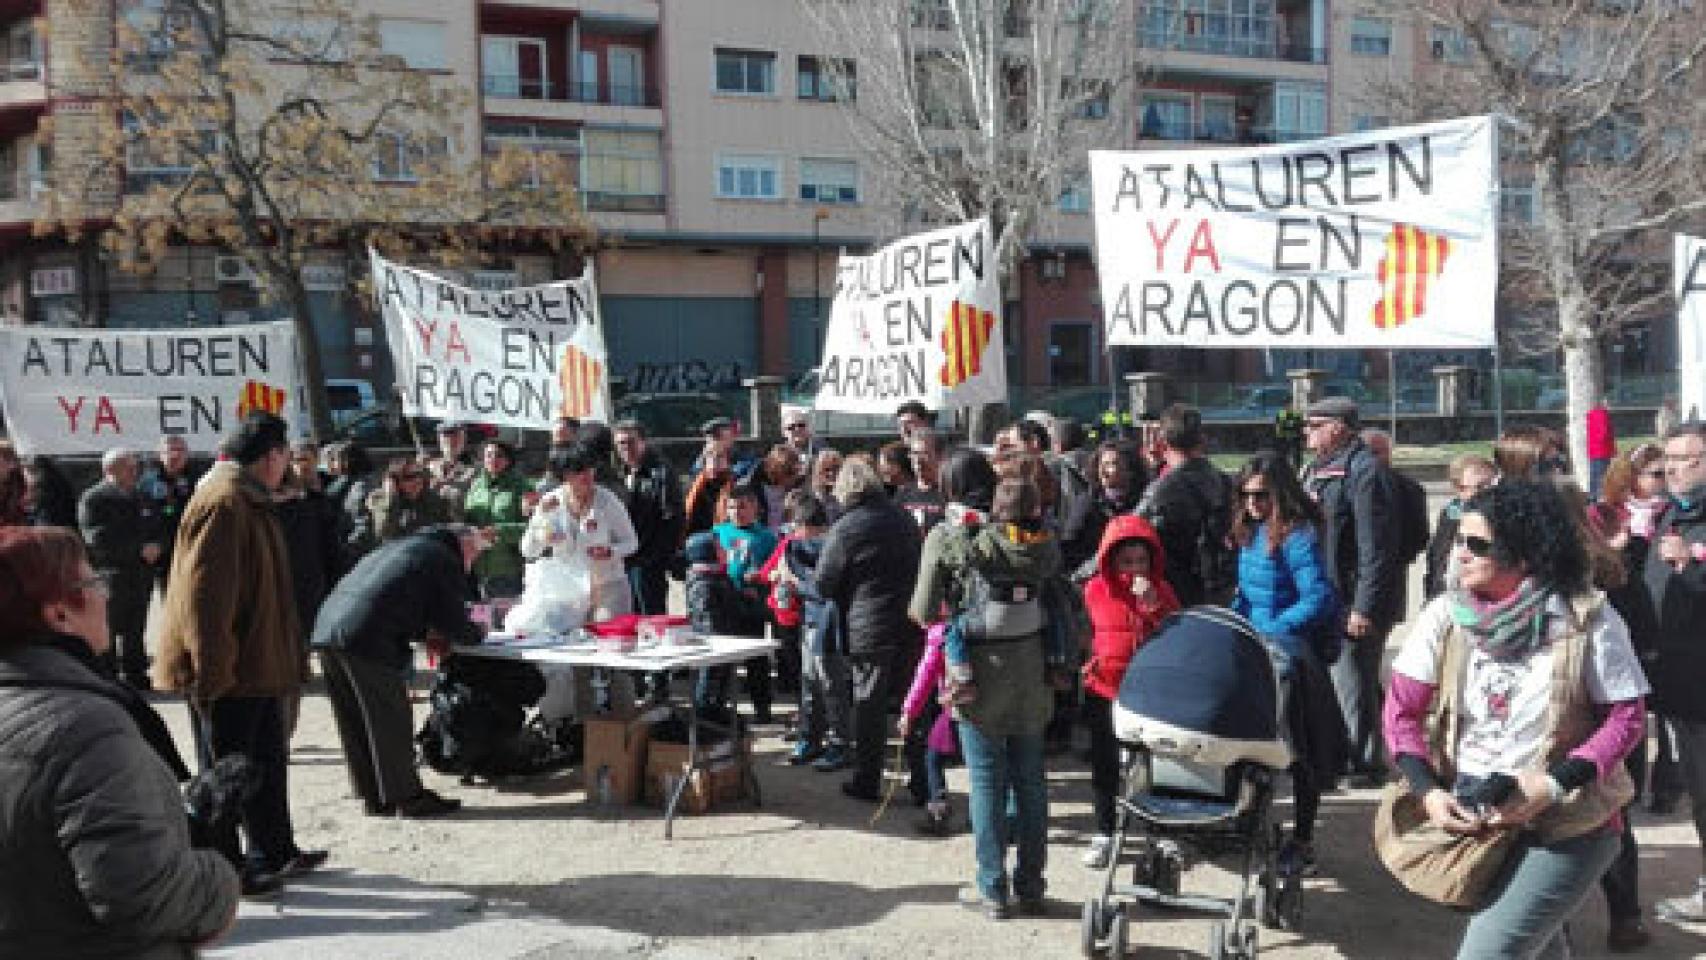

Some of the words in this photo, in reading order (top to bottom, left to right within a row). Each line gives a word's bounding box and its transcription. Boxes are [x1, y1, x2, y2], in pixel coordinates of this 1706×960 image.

[1112, 135, 1434, 212] ATALUREN
[1146, 217, 1222, 274] YA
[1274, 213, 1362, 271] EN
[884, 296, 933, 346] EN
[1108, 278, 1347, 336] ARAGON
[22, 334, 270, 377] ATALUREN
[414, 319, 472, 364] YA
[501, 327, 557, 373] EN
[57, 395, 123, 435] YA
[158, 395, 223, 435] EN
[408, 364, 550, 421] RAGON
